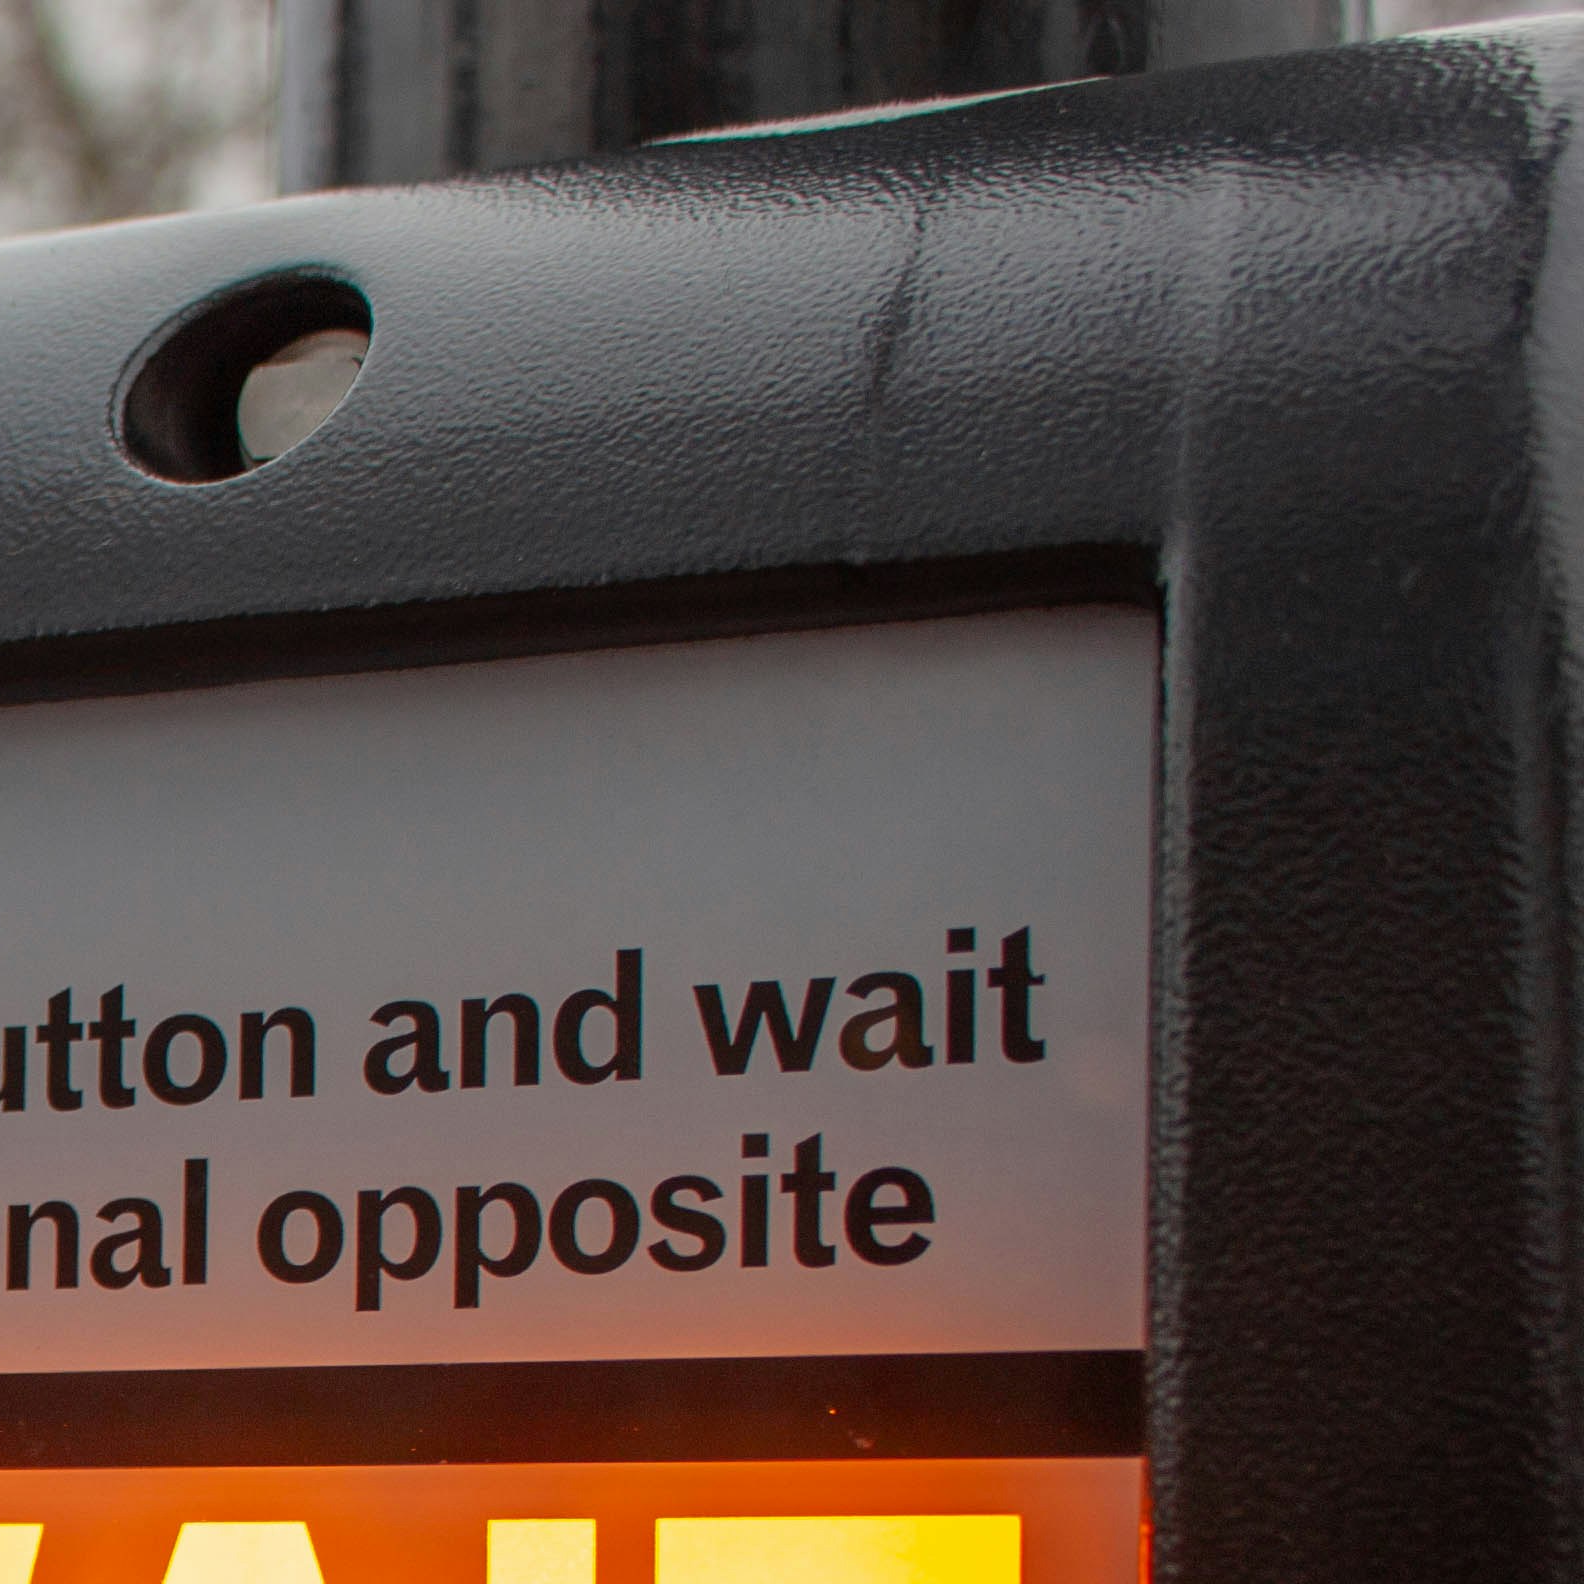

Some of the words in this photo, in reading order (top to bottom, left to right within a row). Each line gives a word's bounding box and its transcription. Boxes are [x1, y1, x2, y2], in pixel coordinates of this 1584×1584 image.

[362, 946, 644, 1097] and
[691, 924, 1048, 1077] wait
[256, 1131, 937, 1313] opposite
